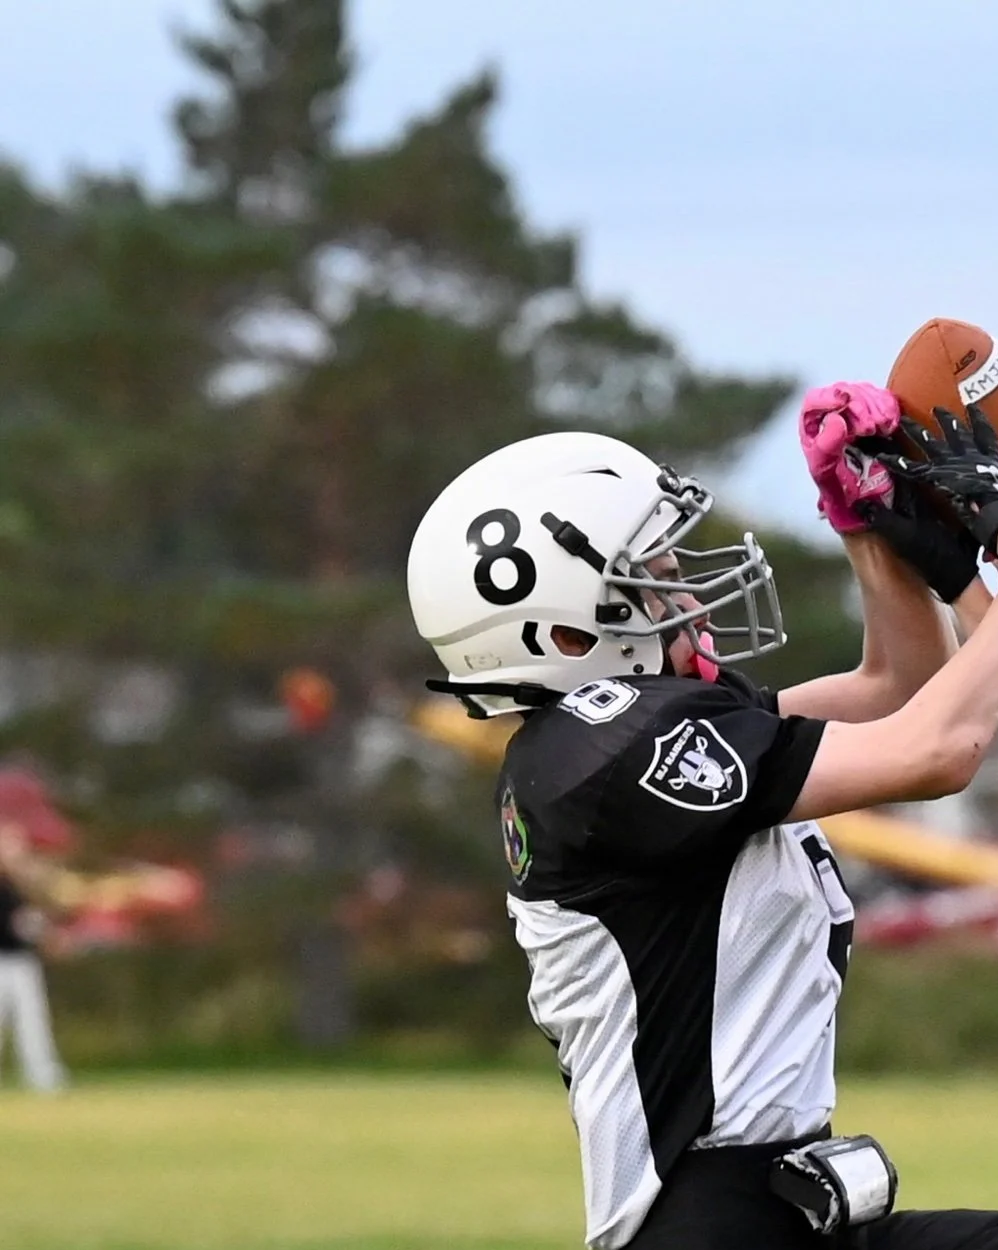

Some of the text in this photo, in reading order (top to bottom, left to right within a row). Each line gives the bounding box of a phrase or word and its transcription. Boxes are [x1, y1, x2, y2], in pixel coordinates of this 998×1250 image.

[466, 508, 537, 606] 8
[556, 678, 641, 725] 8
[664, 725, 696, 766] RAIDERS
